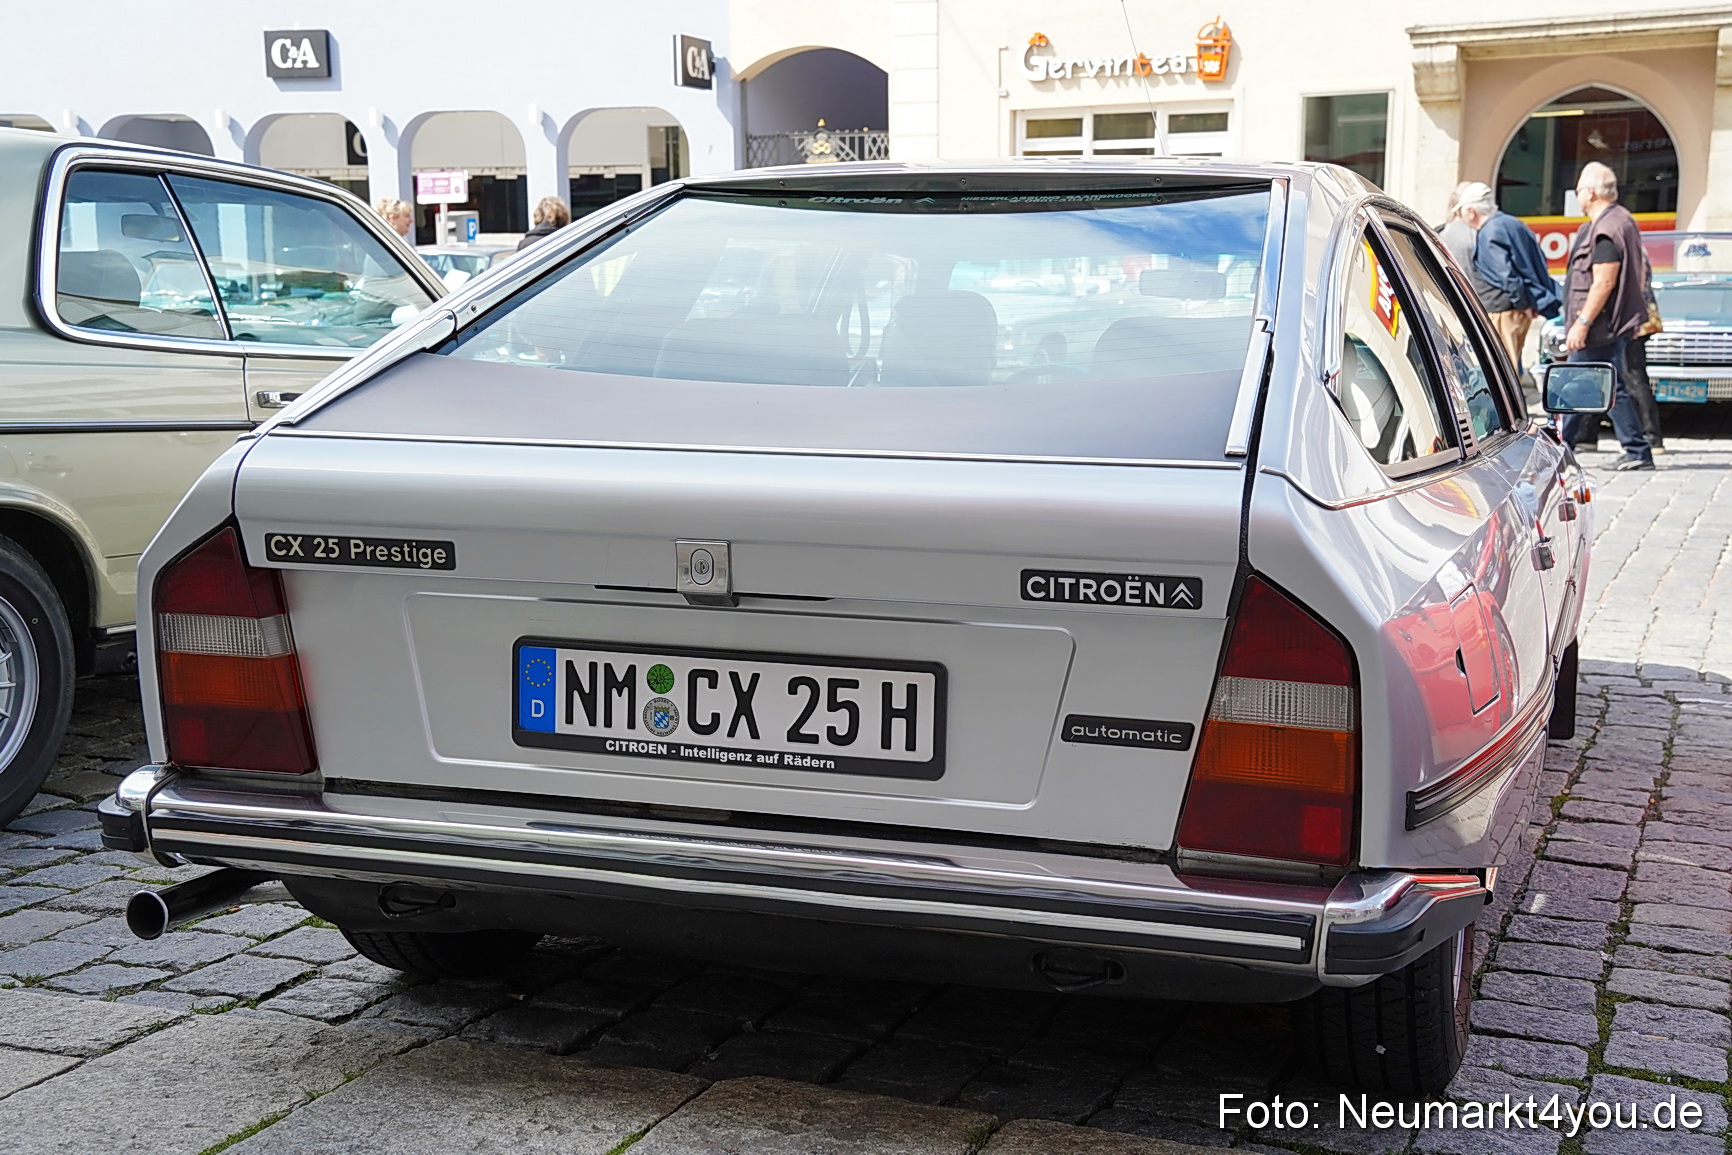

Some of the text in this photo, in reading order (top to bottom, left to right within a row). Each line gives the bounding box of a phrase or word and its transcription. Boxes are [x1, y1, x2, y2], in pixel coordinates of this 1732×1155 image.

[271, 38, 320, 69] C&A
[686, 46, 711, 80] C&A
[468, 221, 477, 238] P
[270, 535, 447, 569] CX 25 Prestige
[1026, 575, 1165, 605] CITROËN
[531, 699, 545, 718] D
[565, 660, 636, 730] NM
[687, 668, 761, 740] CX
[786, 675, 860, 747] 25
[1071, 725, 1182, 743] automatic
[605, 739, 668, 755] CITROEN
[680, 746, 752, 763] Intelligenz
[756, 753, 779, 764] auf
[784, 754, 835, 769] Rädern
